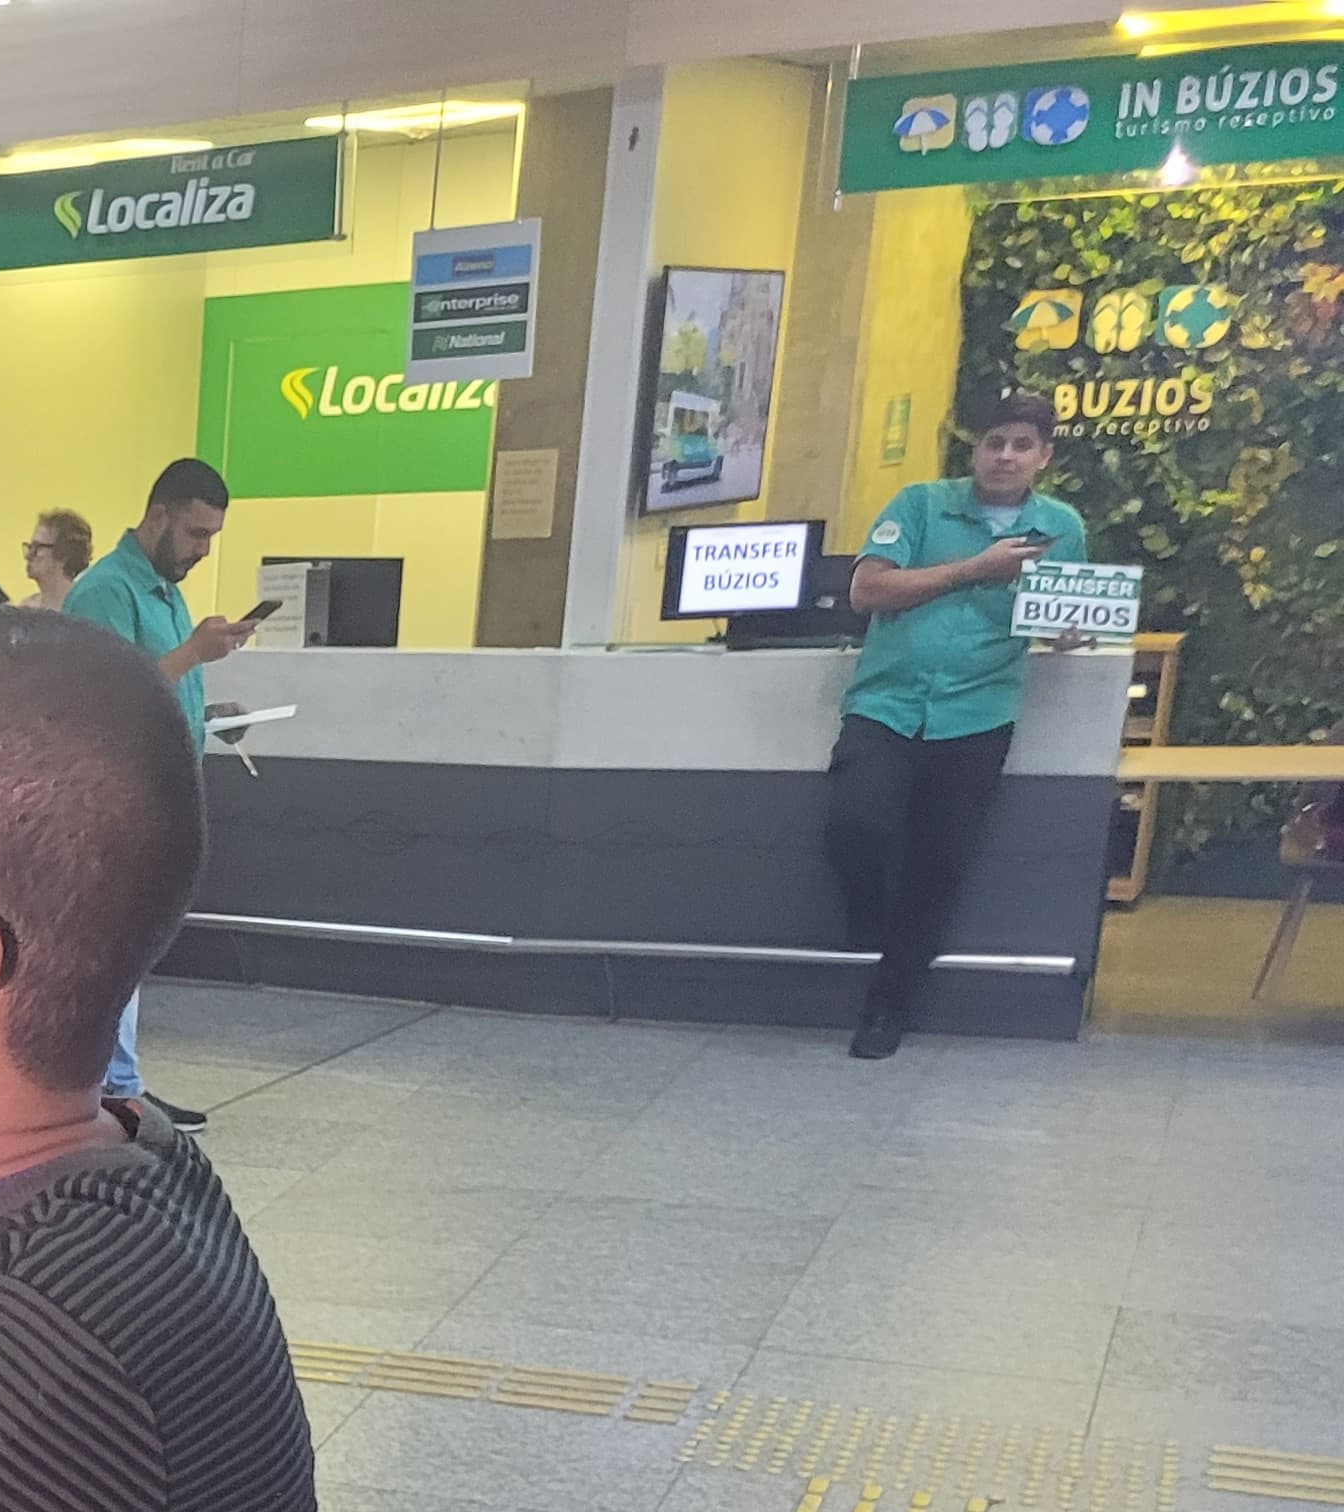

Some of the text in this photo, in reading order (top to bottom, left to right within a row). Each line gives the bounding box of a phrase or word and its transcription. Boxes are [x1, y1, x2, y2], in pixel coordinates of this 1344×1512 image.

[1117, 63, 1339, 120] IN BÚZIOS
[1115, 116, 1208, 139] turismo
[170, 149, 257, 175] Rent a Car
[86, 176, 256, 235] Localiza
[423, 292, 520, 312] enterprise
[448, 331, 506, 349] National
[692, 541, 798, 562] TRANSFER
[703, 568, 780, 591] BÚZIOS
[1026, 575, 1135, 597] TRANSFER
[1023, 597, 1131, 628] BÚZIOS
